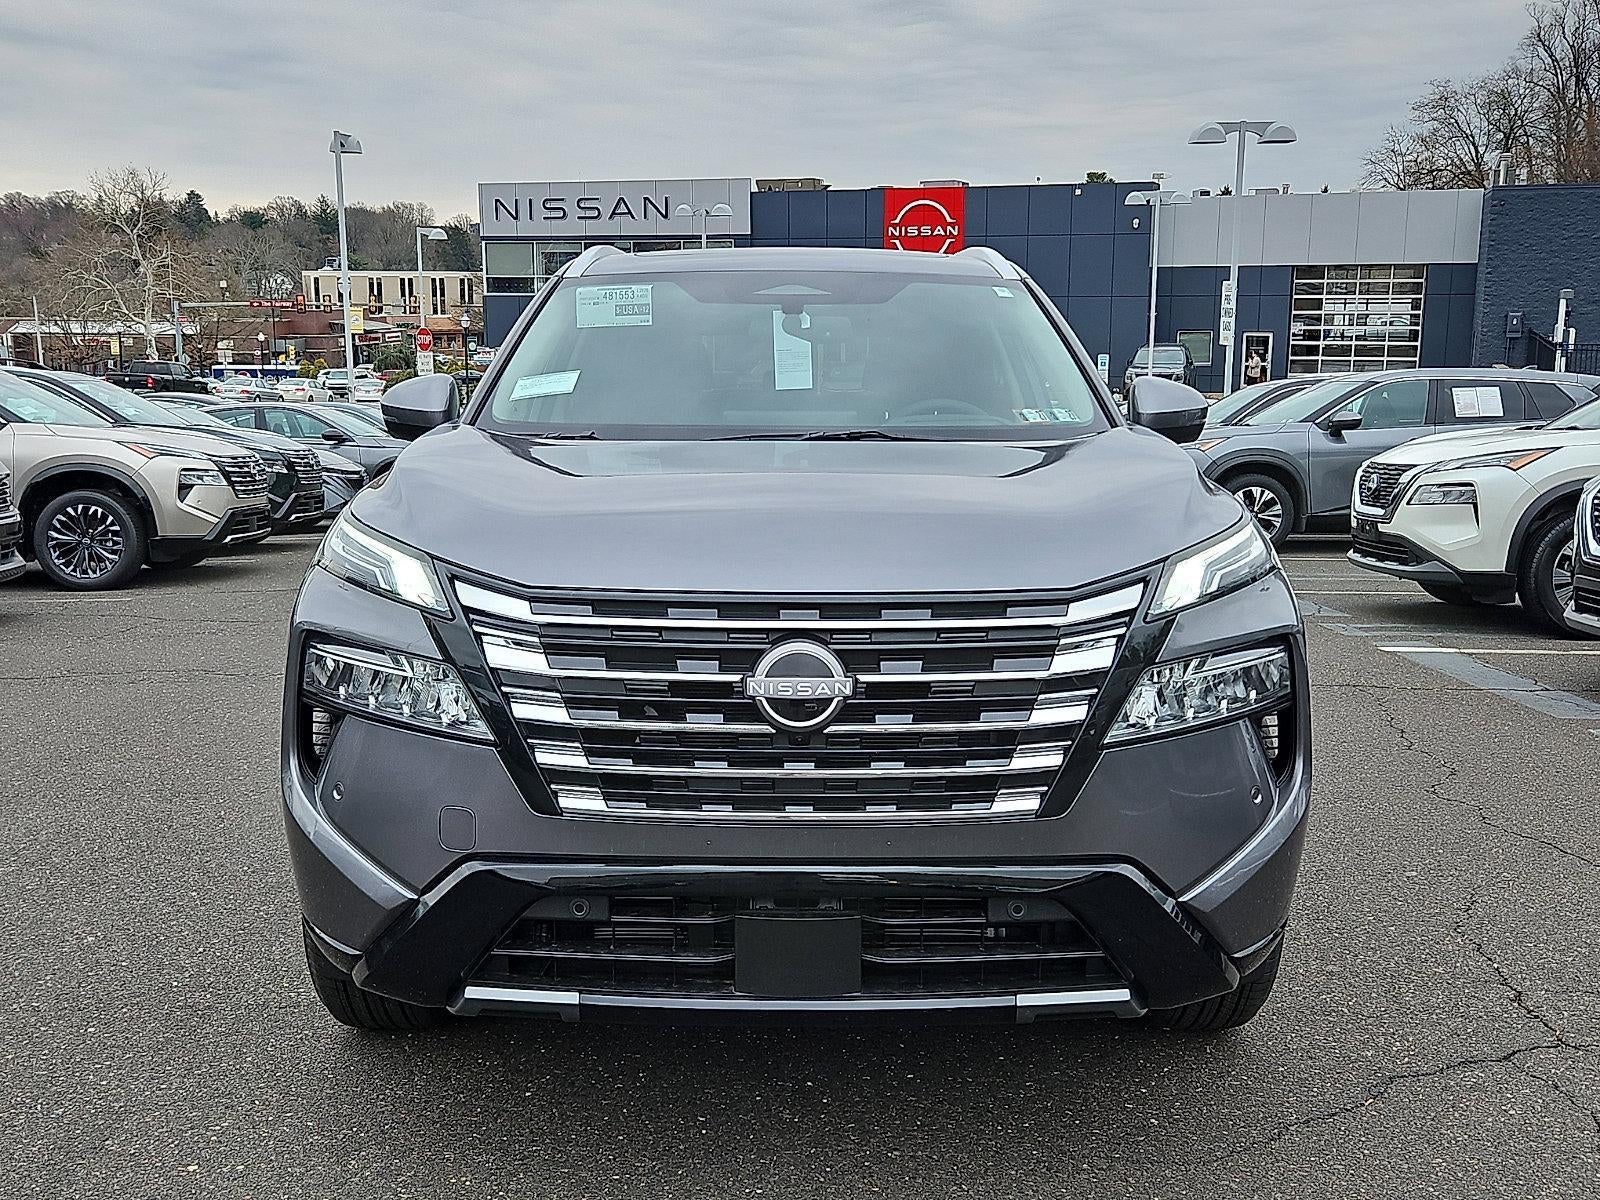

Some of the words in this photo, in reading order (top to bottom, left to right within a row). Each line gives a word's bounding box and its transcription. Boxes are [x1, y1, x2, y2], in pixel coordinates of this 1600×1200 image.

[493, 195, 671, 222] NISSAN
[888, 225, 959, 237] NISSAN
[602, 290, 635, 301] 481553
[272, 300, 293, 308] Fairway
[622, 304, 639, 315] USA
[417, 334, 431, 345] STOP
[748, 680, 851, 697] NISSAN
